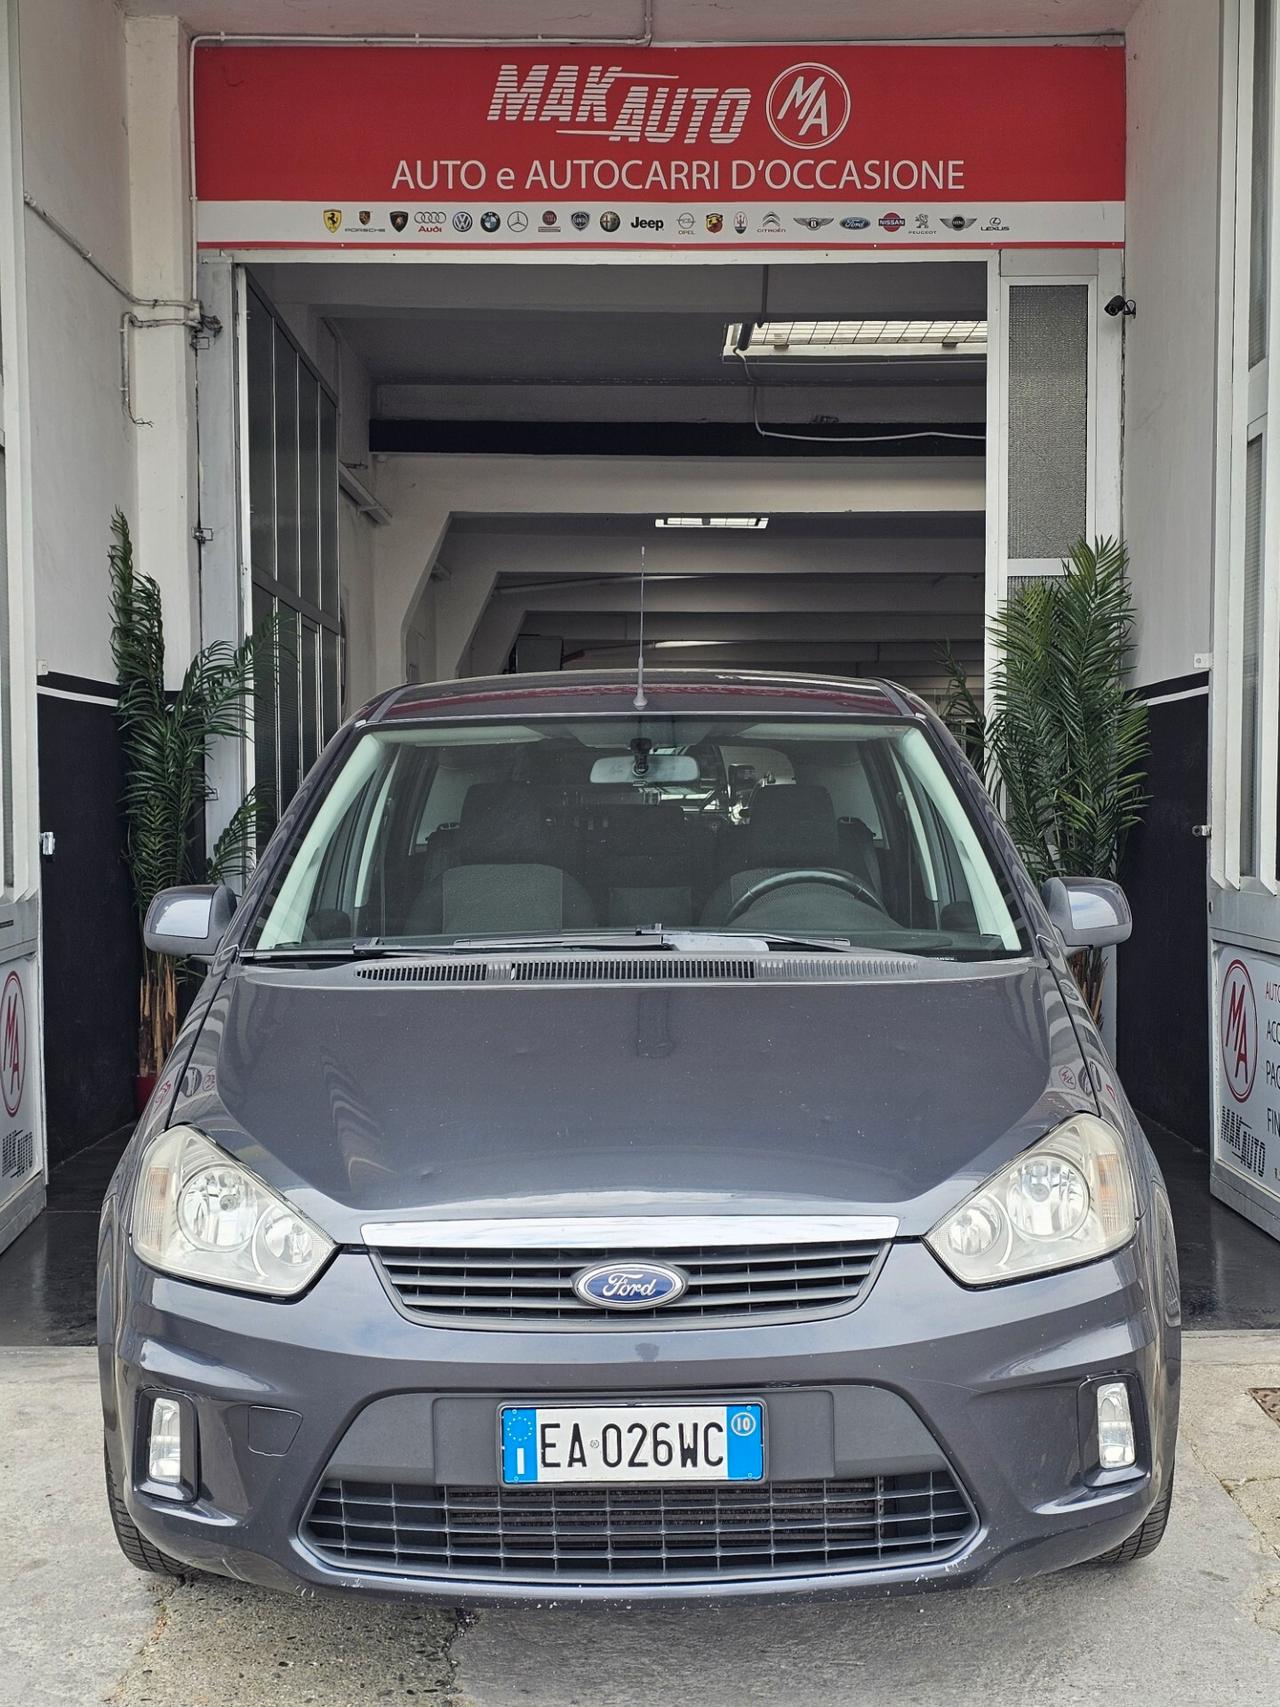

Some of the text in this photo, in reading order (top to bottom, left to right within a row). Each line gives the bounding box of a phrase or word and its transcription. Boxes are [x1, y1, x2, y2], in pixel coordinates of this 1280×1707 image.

[487, 64, 752, 145] MAK AUTO
[392, 159, 487, 191] AUTO
[496, 168, 516, 191] e
[525, 159, 719, 191] AUTOCARRI
[418, 225, 442, 233] Audi
[630, 216, 664, 231] Jeep
[844, 218, 866, 229] Ford
[602, 1272, 656, 1297] Ford
